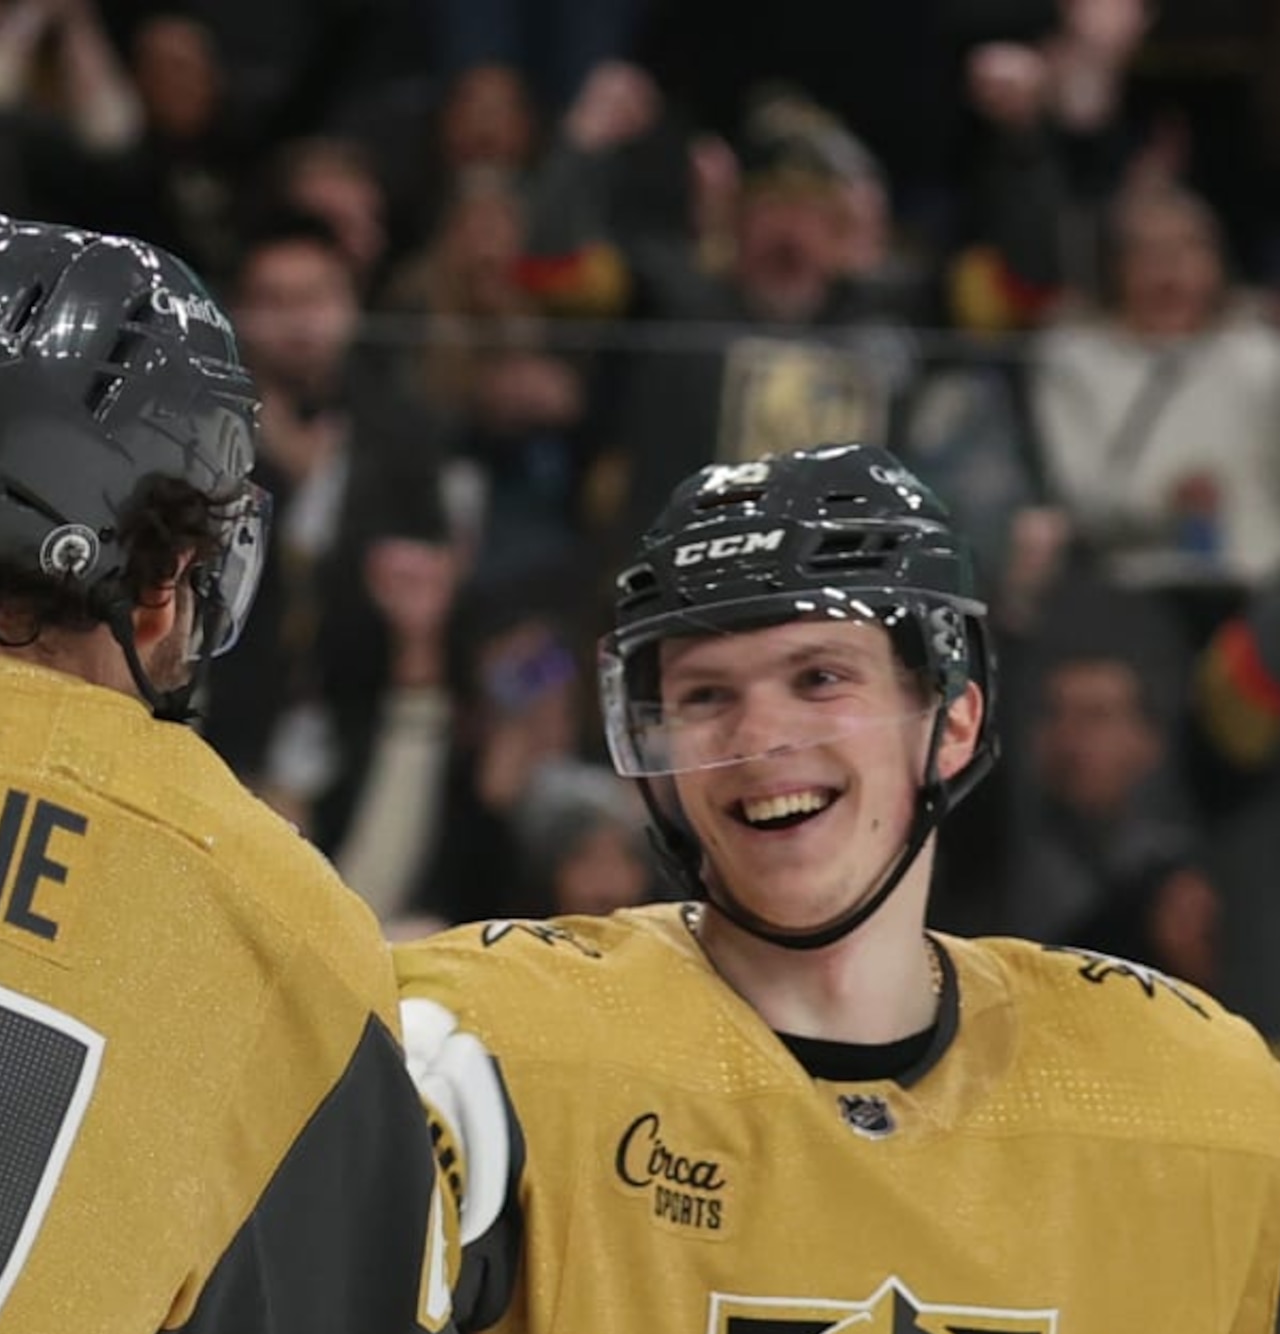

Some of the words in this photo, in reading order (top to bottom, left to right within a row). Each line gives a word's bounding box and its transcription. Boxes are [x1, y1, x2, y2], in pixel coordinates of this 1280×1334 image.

[674, 529, 786, 567] CCM
[616, 1112, 726, 1191] Circa
[654, 1184, 723, 1230] SPORTS
